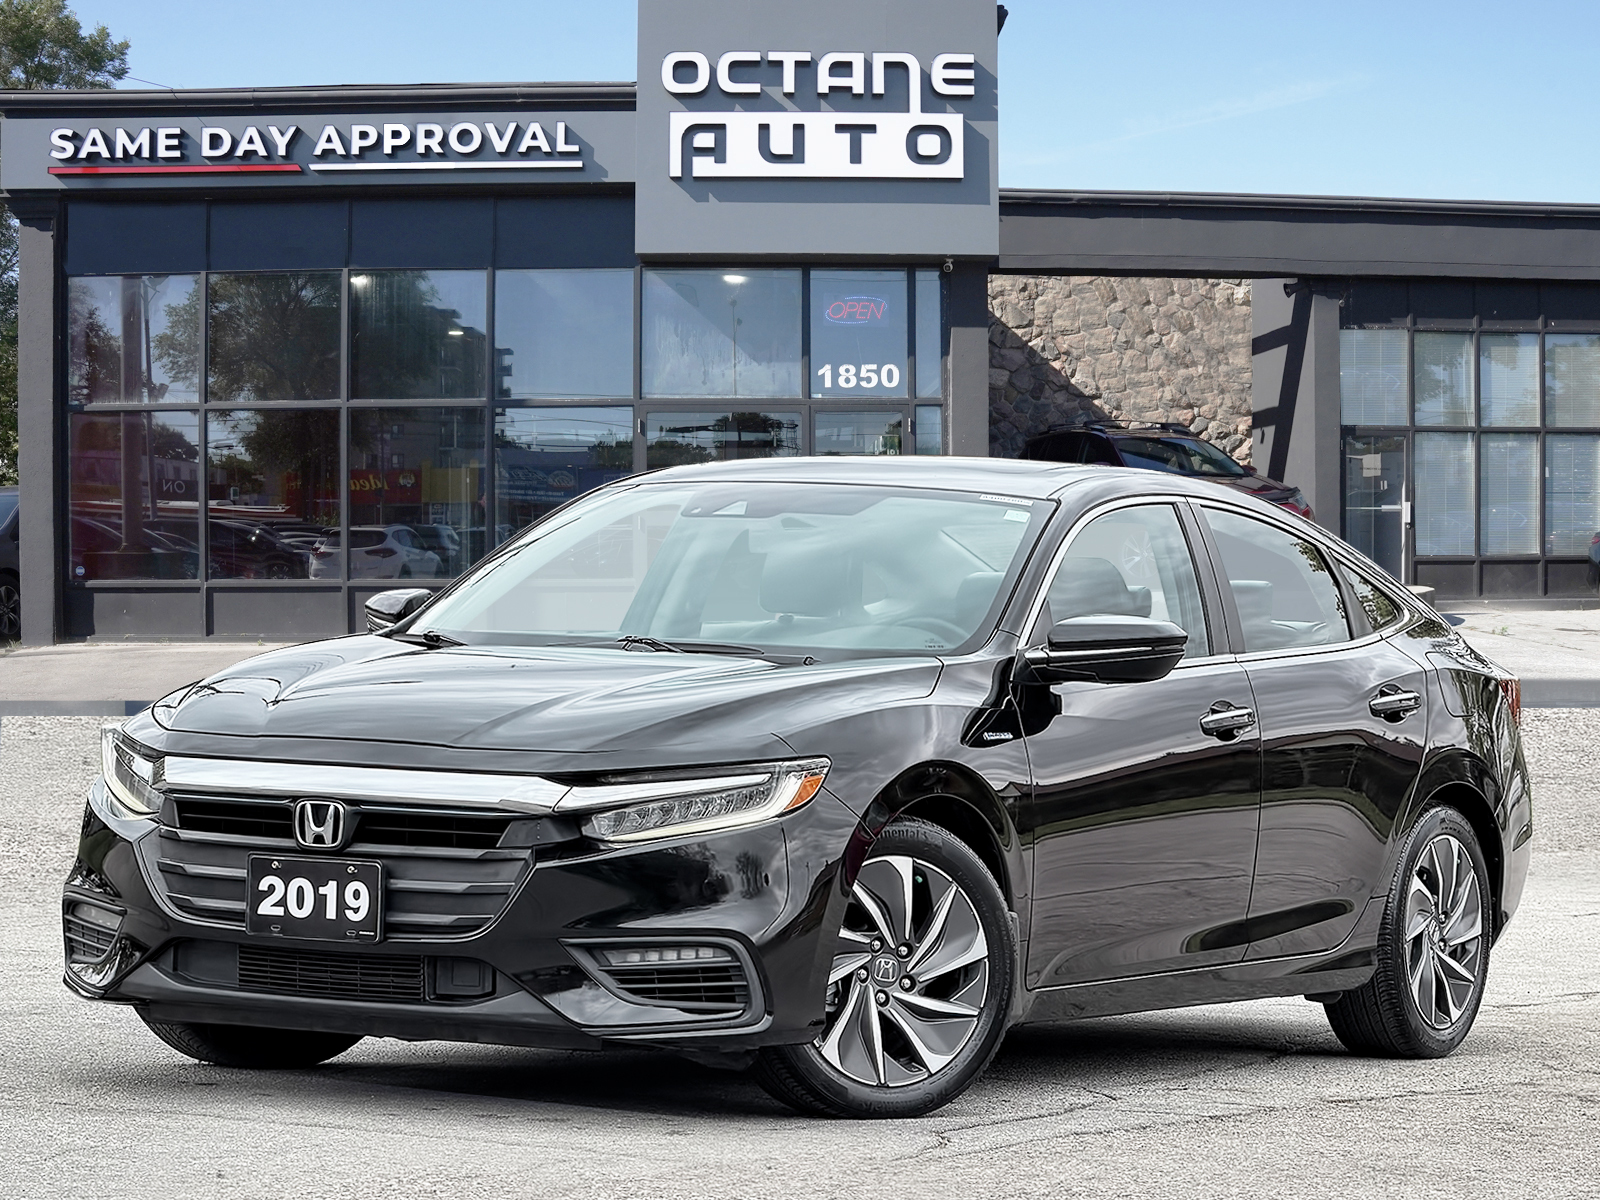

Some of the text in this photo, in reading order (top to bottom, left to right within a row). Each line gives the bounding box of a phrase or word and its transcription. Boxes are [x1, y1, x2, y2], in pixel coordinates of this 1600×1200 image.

[661, 50, 976, 113] OCTANE
[49, 121, 580, 160] SAME DAY APPROVAL
[681, 122, 953, 178] AUTO
[828, 301, 885, 320] OPEN
[817, 363, 901, 389] 1850
[256, 874, 371, 923] 2019
